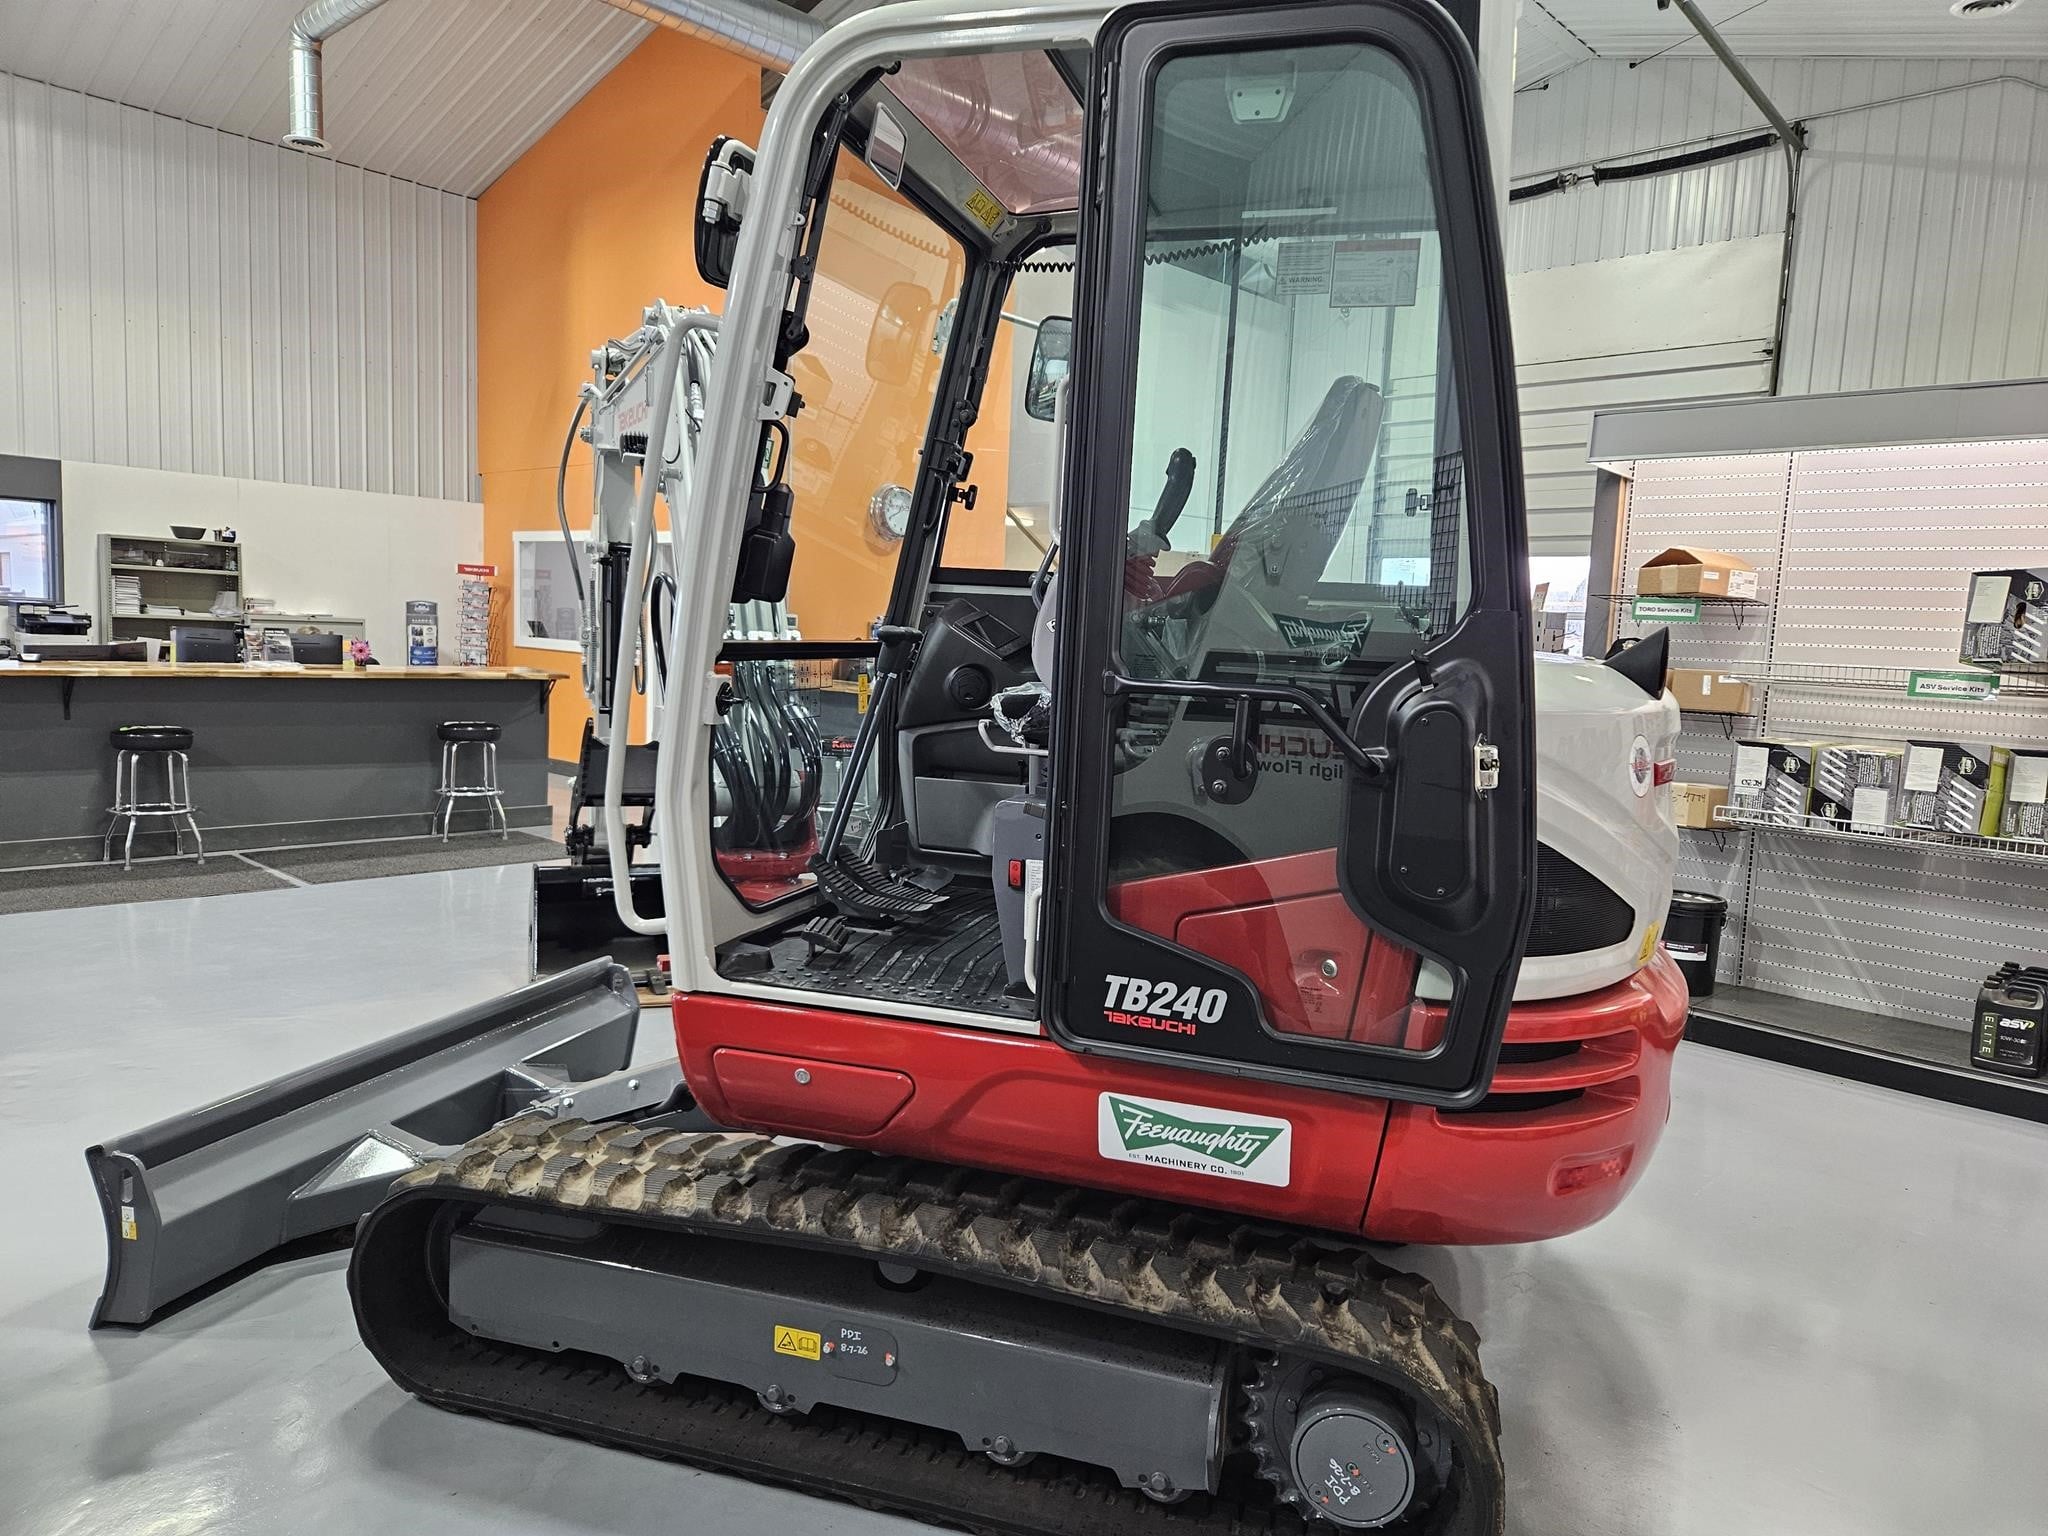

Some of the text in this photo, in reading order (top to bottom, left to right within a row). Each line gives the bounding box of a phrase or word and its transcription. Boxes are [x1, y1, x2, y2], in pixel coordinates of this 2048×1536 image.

[1289, 276, 1323, 284] WARNING
[1937, 684, 1967, 692] Service
[1104, 974, 1228, 1024] TB240
[1103, 1010, 1197, 1036] TAKEUCHI
[1982, 1016, 1994, 1053] ELITE
[1118, 1103, 1270, 1164] Feenaughty
[1145, 1154, 1207, 1171] MACHINERY
[1210, 1165, 1227, 1174] CO.
[841, 1328, 861, 1341] PDI
[1324, 1475, 1351, 1505] PDI
